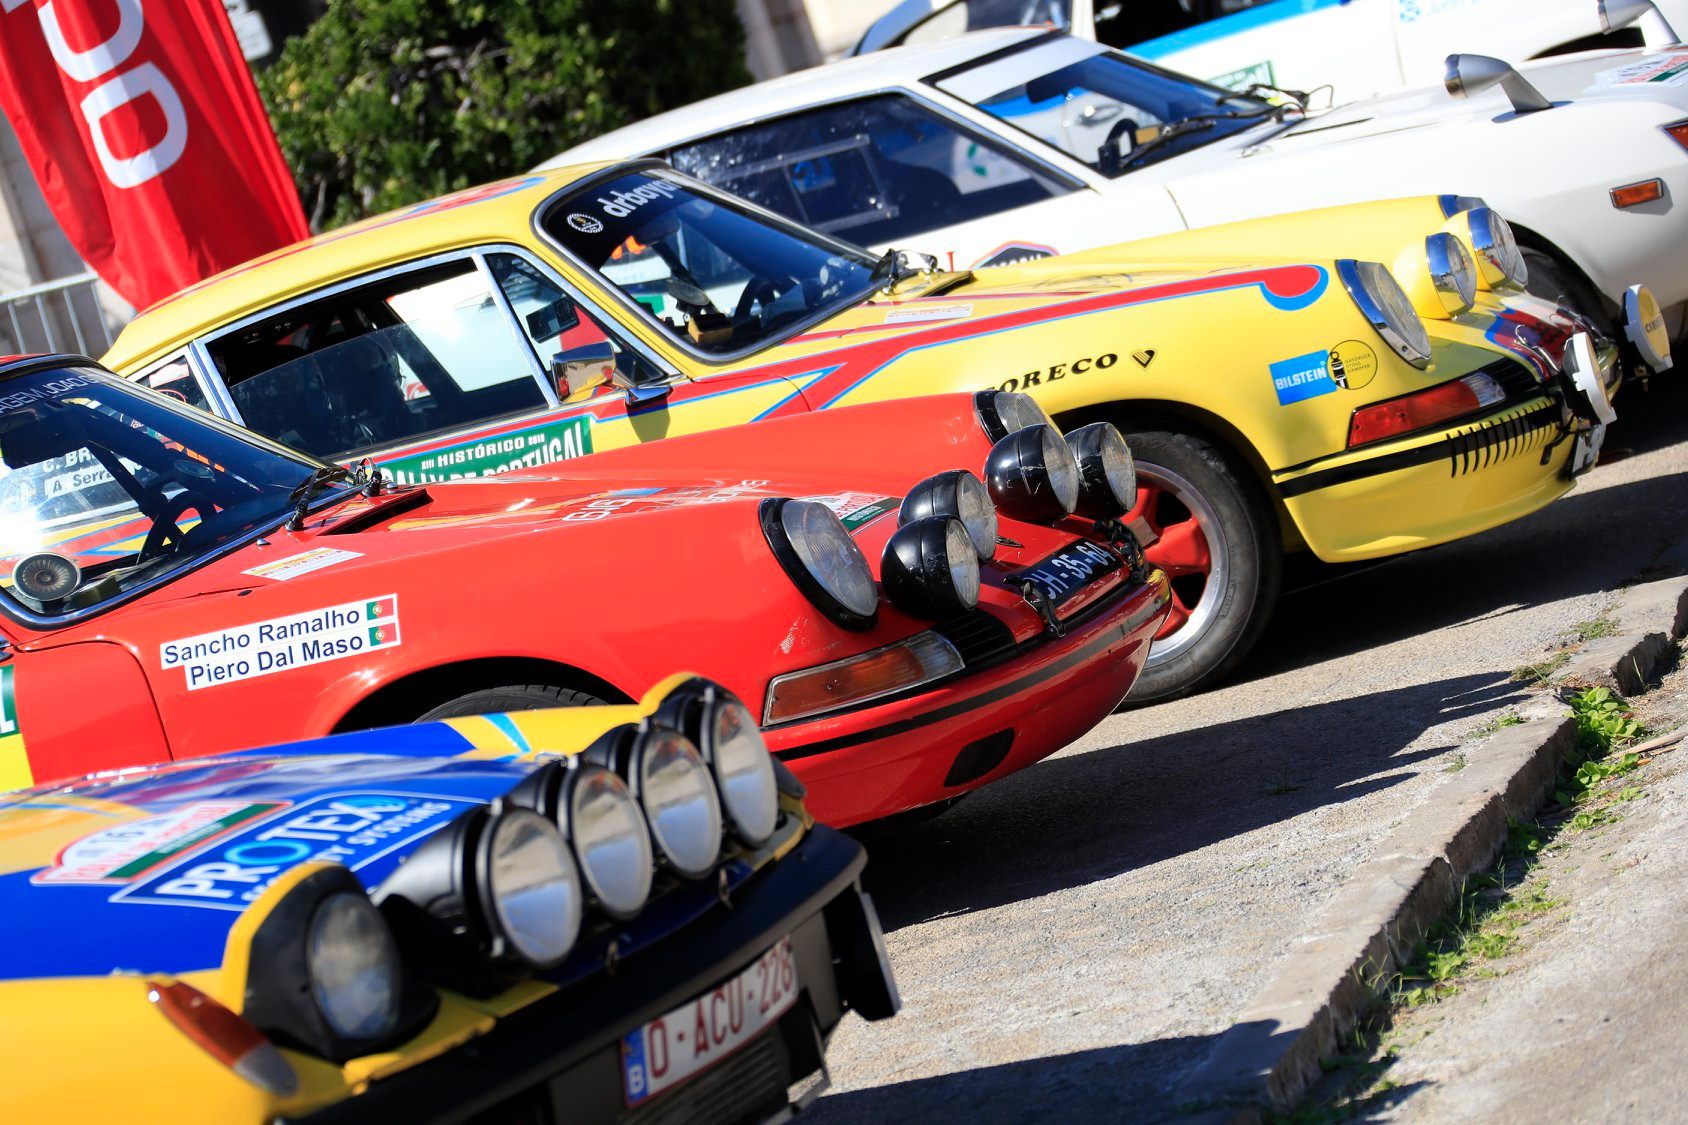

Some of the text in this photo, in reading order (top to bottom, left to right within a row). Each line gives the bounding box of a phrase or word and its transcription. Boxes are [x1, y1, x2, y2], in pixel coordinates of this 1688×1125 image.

[984, 353, 1118, 393] ORECO
[1275, 366, 1328, 391] BILSTEIN
[437, 436, 525, 468] HISTÓRICO
[164, 609, 360, 665] Sancho Ramalho
[190, 635, 364, 686] Piero Dal Maso
[346, 801, 452, 846] SYSTEMS
[154, 801, 404, 899] PROTEX
[628, 1064, 645, 1096] B
